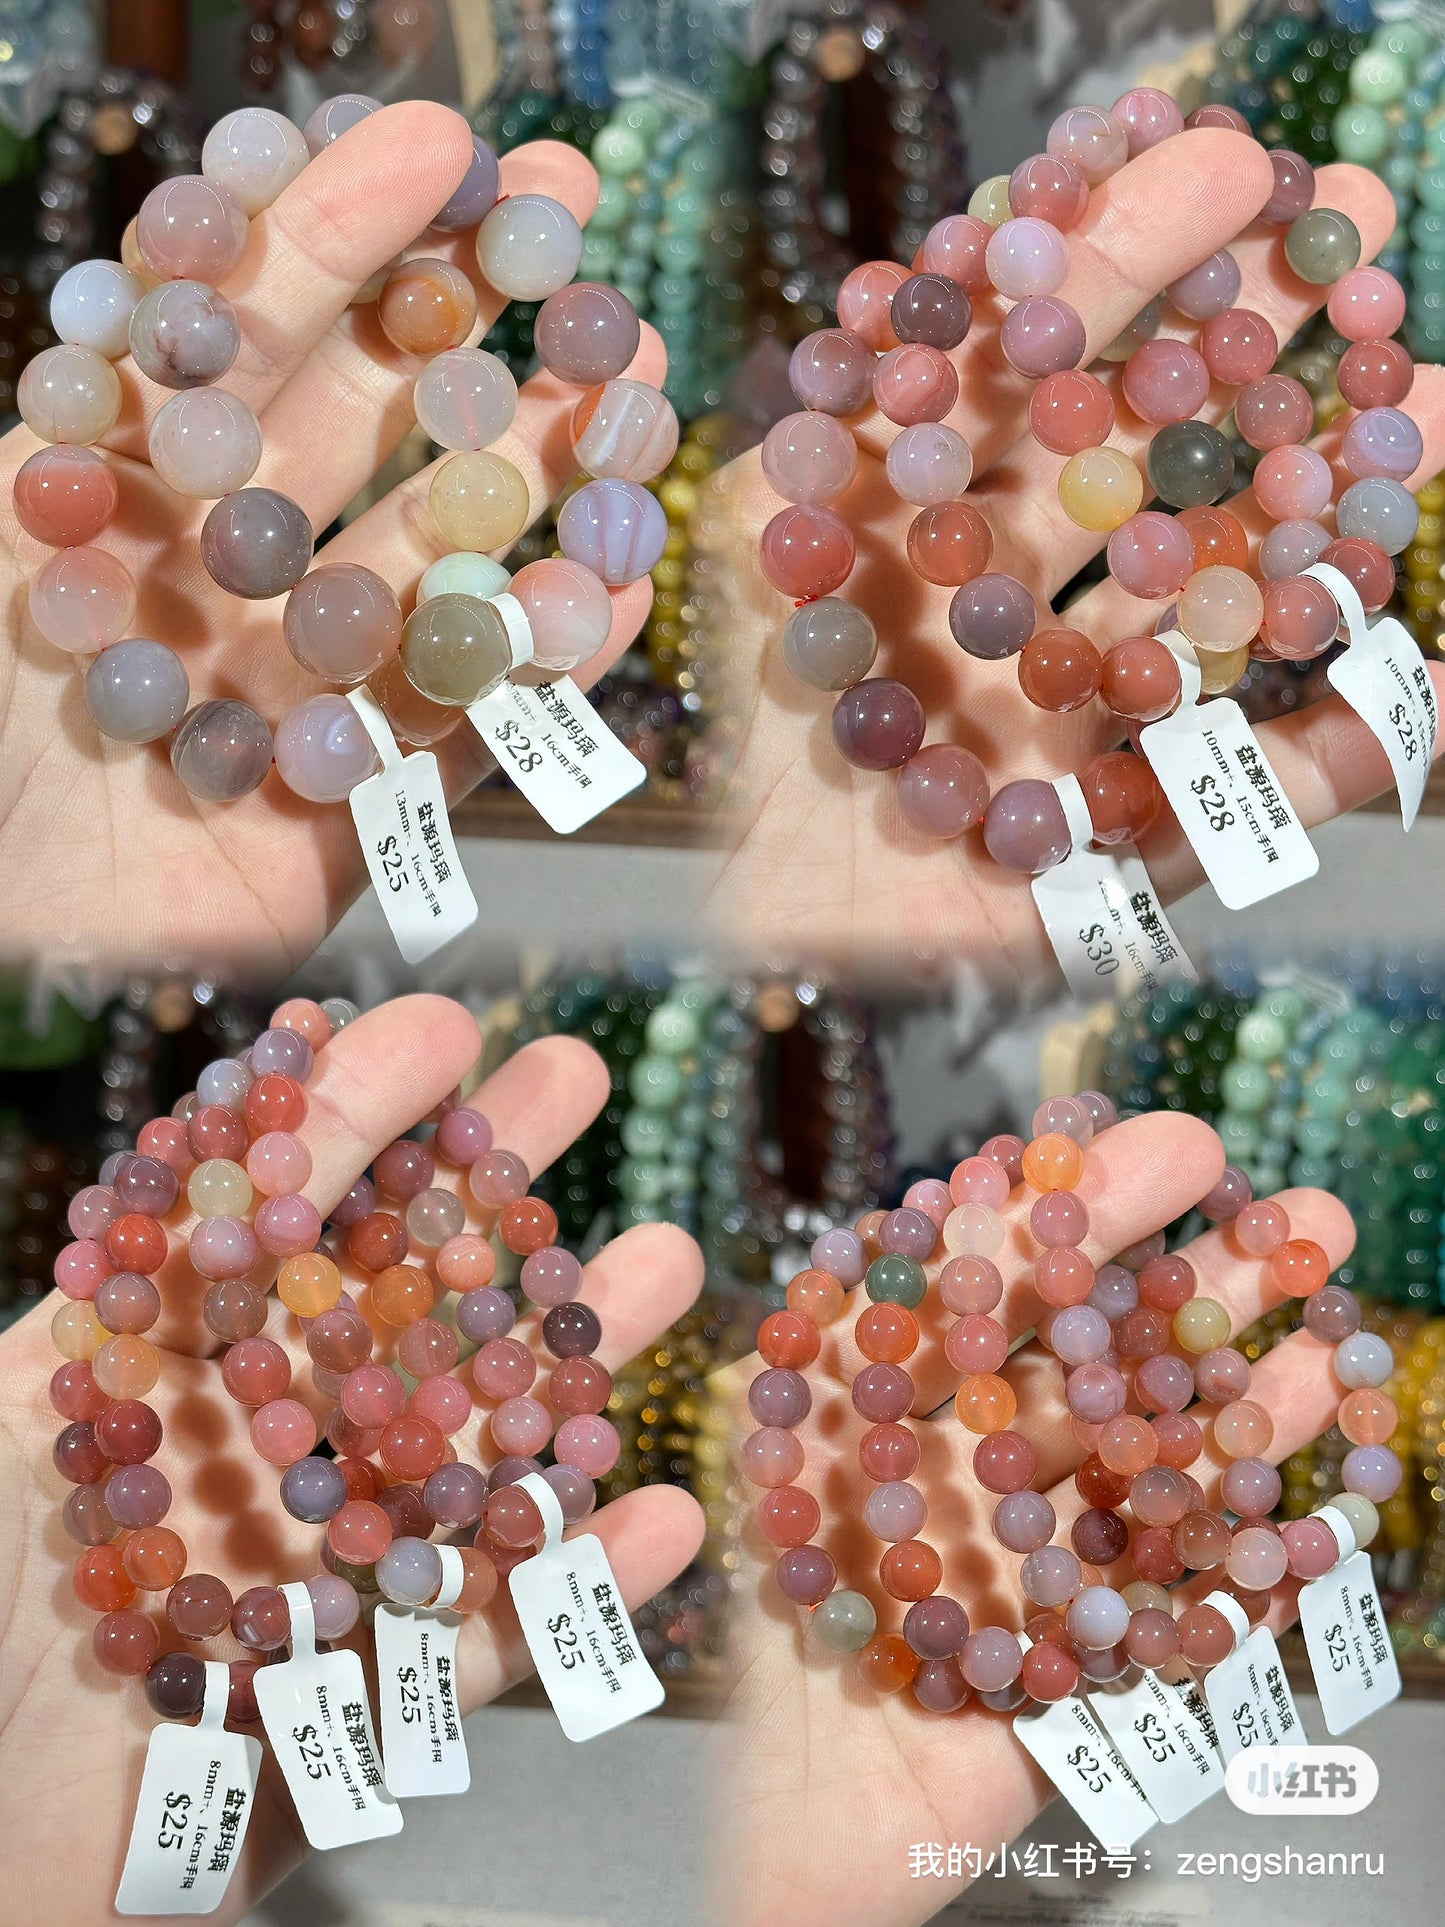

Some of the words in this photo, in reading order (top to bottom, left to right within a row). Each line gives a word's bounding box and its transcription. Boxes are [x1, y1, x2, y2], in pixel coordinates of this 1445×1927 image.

[494, 720, 543, 773] $28
[533, 681, 600, 757] 盐源玛瑙
[1389, 703, 1418, 761] $28
[1190, 774, 1235, 832] $28
[1234, 743, 1292, 830] 盐源玛瑙
[377, 835, 410, 893] $25
[416, 801, 451, 884] 盐源玛瑙
[1077, 922, 1120, 976] $30
[1130, 890, 1178, 965] 盐源玛瑙
[547, 1611, 585, 1671] $25
[590, 1583, 637, 1667] 盐源玛瑙
[1321, 1624, 1351, 1673] $25
[1359, 1592, 1389, 1667] 盐源玛瑙
[399, 1665, 422, 1724] $25
[436, 1655, 460, 1742] 盐源玛瑙
[1265, 1664, 1296, 1733] 盐源玛瑙
[292, 1725, 332, 1782] $25
[341, 1700, 383, 1788] 盐源玛瑙
[1133, 1713, 1177, 1765] $25
[1231, 1702, 1259, 1748] $25
[1066, 1744, 1113, 1795] $25
[157, 1790, 190, 1851] $25
[206, 1787, 247, 1875] 盐源玛瑙
